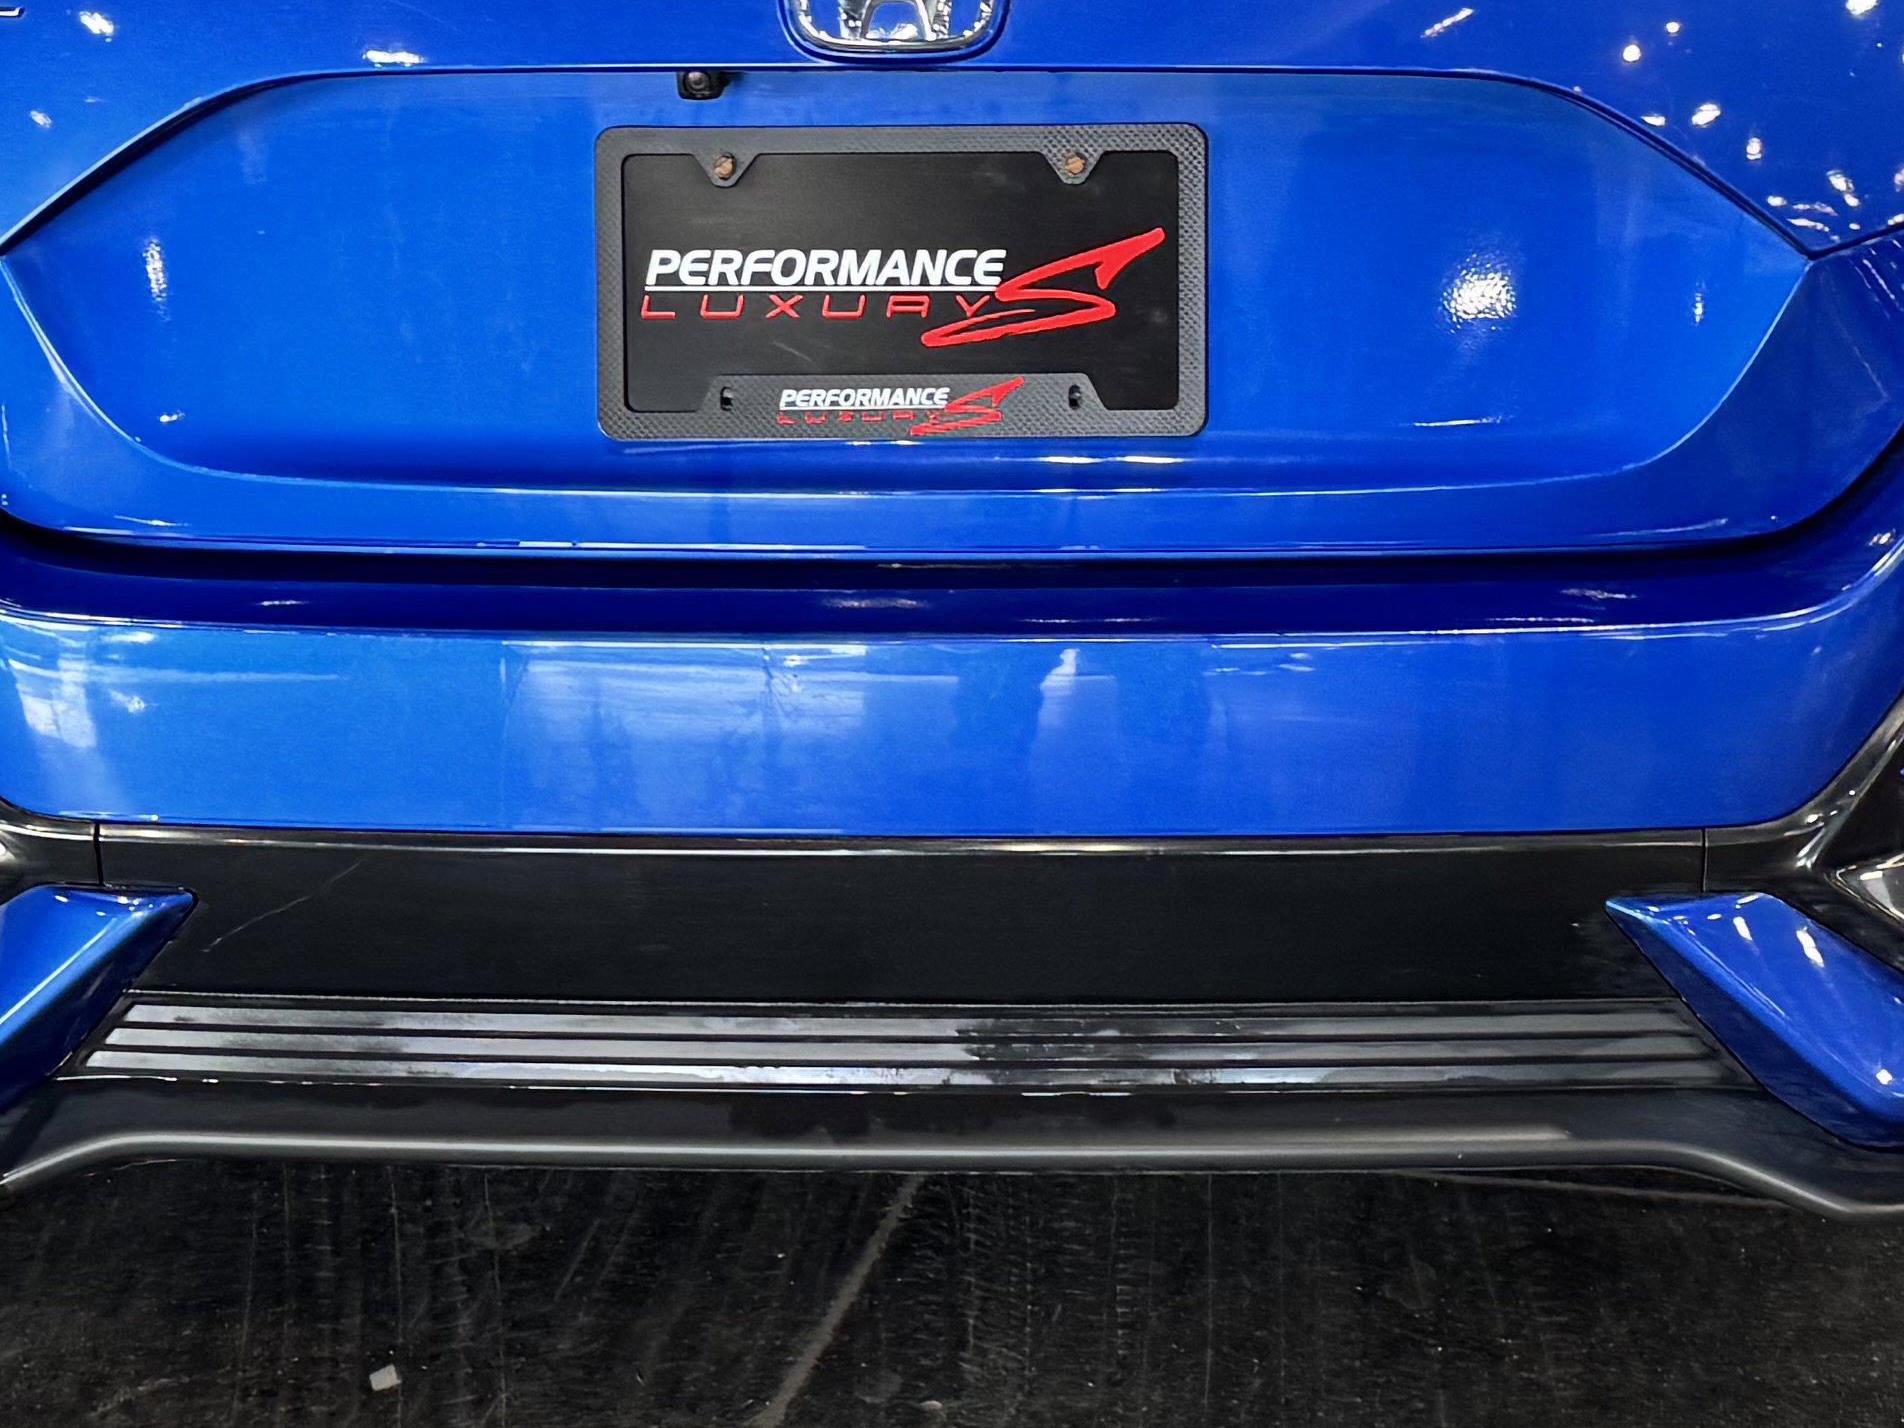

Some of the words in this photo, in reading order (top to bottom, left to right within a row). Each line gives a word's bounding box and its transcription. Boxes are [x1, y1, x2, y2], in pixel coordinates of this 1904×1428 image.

[646, 249, 1007, 286] PERFORMANCE
[641, 294, 992, 319] LUXURY
[780, 387, 950, 407] PERFORMANCE
